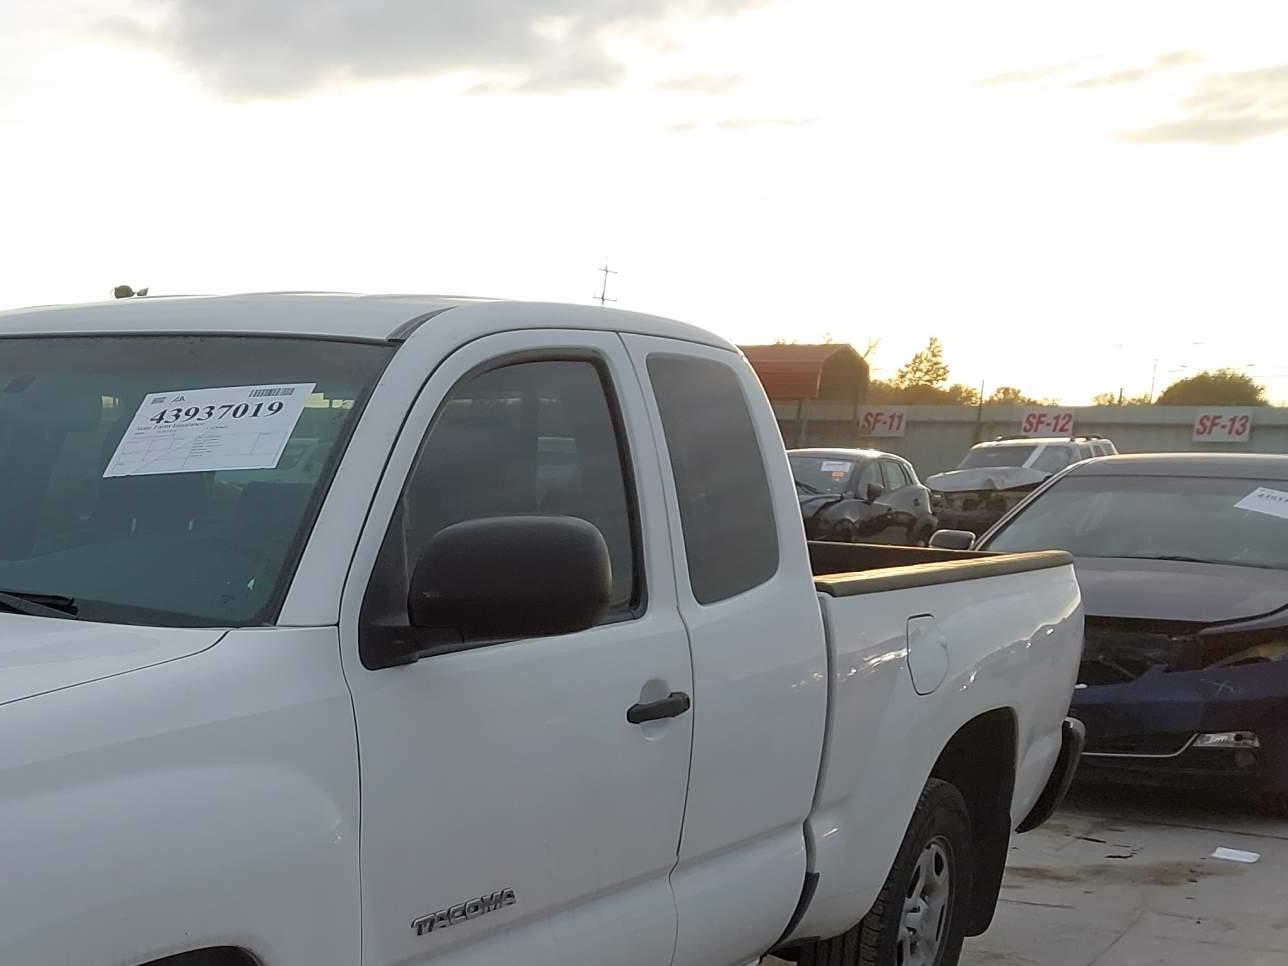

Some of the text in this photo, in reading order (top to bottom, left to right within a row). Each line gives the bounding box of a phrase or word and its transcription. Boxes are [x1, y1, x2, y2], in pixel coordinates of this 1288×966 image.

[149, 401, 284, 424] 43937019
[863, 411, 905, 432] SF-11
[1022, 413, 1073, 433] SF-12
[1196, 415, 1249, 436] SF-13
[411, 888, 516, 935] TACOMA
